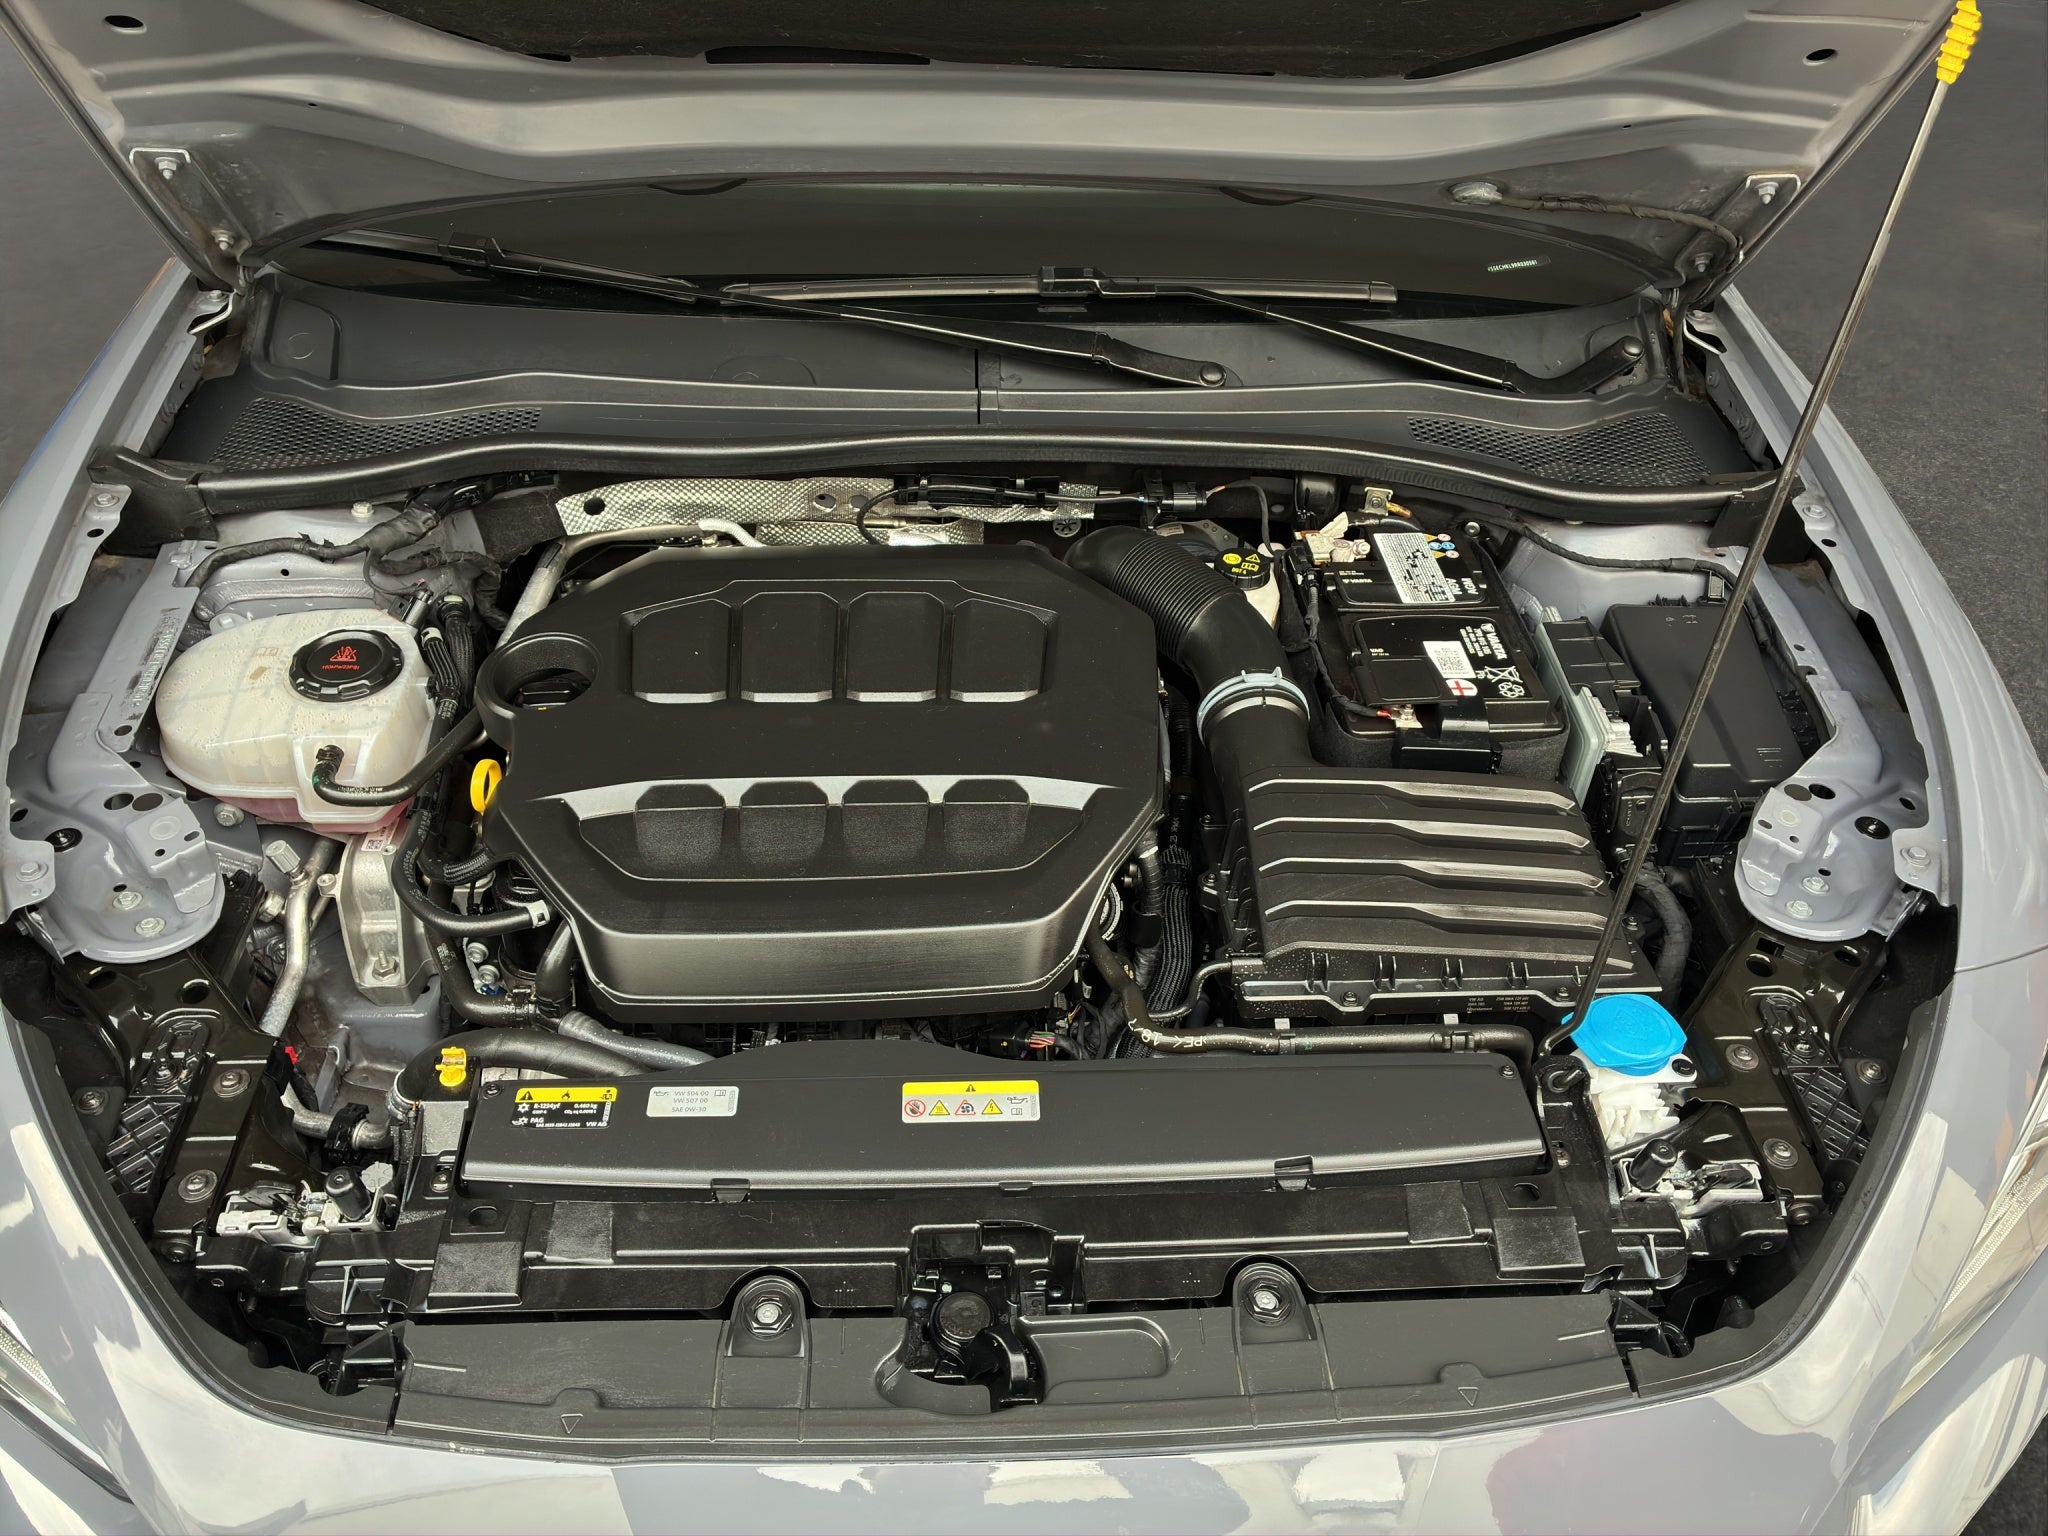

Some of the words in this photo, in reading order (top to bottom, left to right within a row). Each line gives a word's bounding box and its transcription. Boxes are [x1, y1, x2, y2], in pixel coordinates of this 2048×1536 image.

[1445, 578, 1463, 595] AGM
[1461, 577, 1479, 595] AGM
[1486, 632, 1508, 660] VARTA
